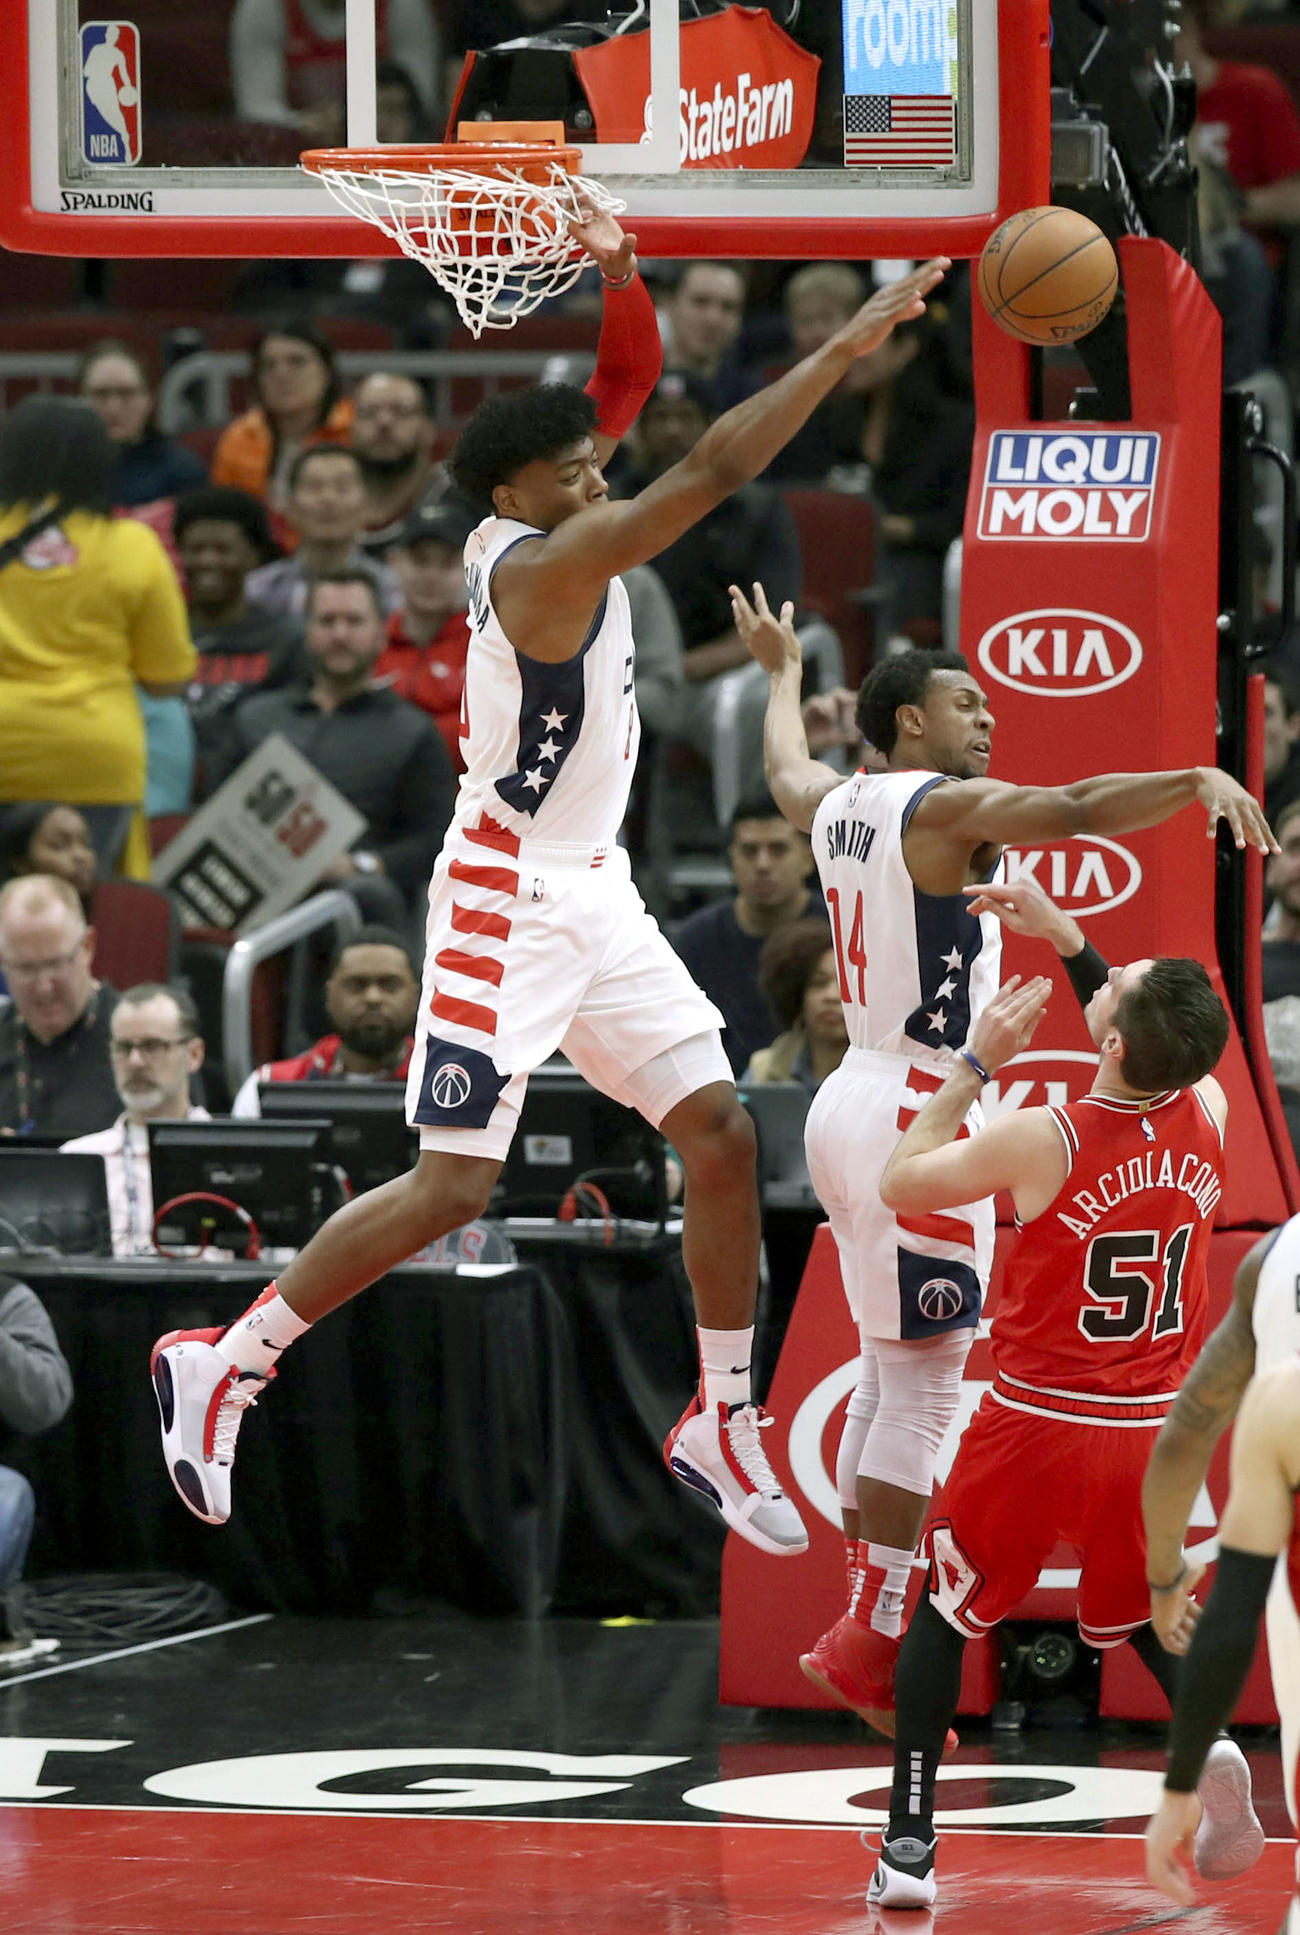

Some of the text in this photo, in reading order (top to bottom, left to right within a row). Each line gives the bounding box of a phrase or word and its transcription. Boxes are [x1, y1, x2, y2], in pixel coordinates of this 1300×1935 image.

[90, 134, 119, 158] NBA
[60, 190, 154, 212] SPALDING
[996, 436, 1150, 483] LIQUI
[988, 489, 1149, 535] MOLY
[1006, 628, 1115, 677] KIA
[827, 819, 876, 863] SMITH
[1004, 850, 1115, 898] KIA
[826, 887, 867, 1008] 14
[1056, 1149, 1222, 1241] ARCIDIACONO
[1077, 1222, 1195, 1343] 51
